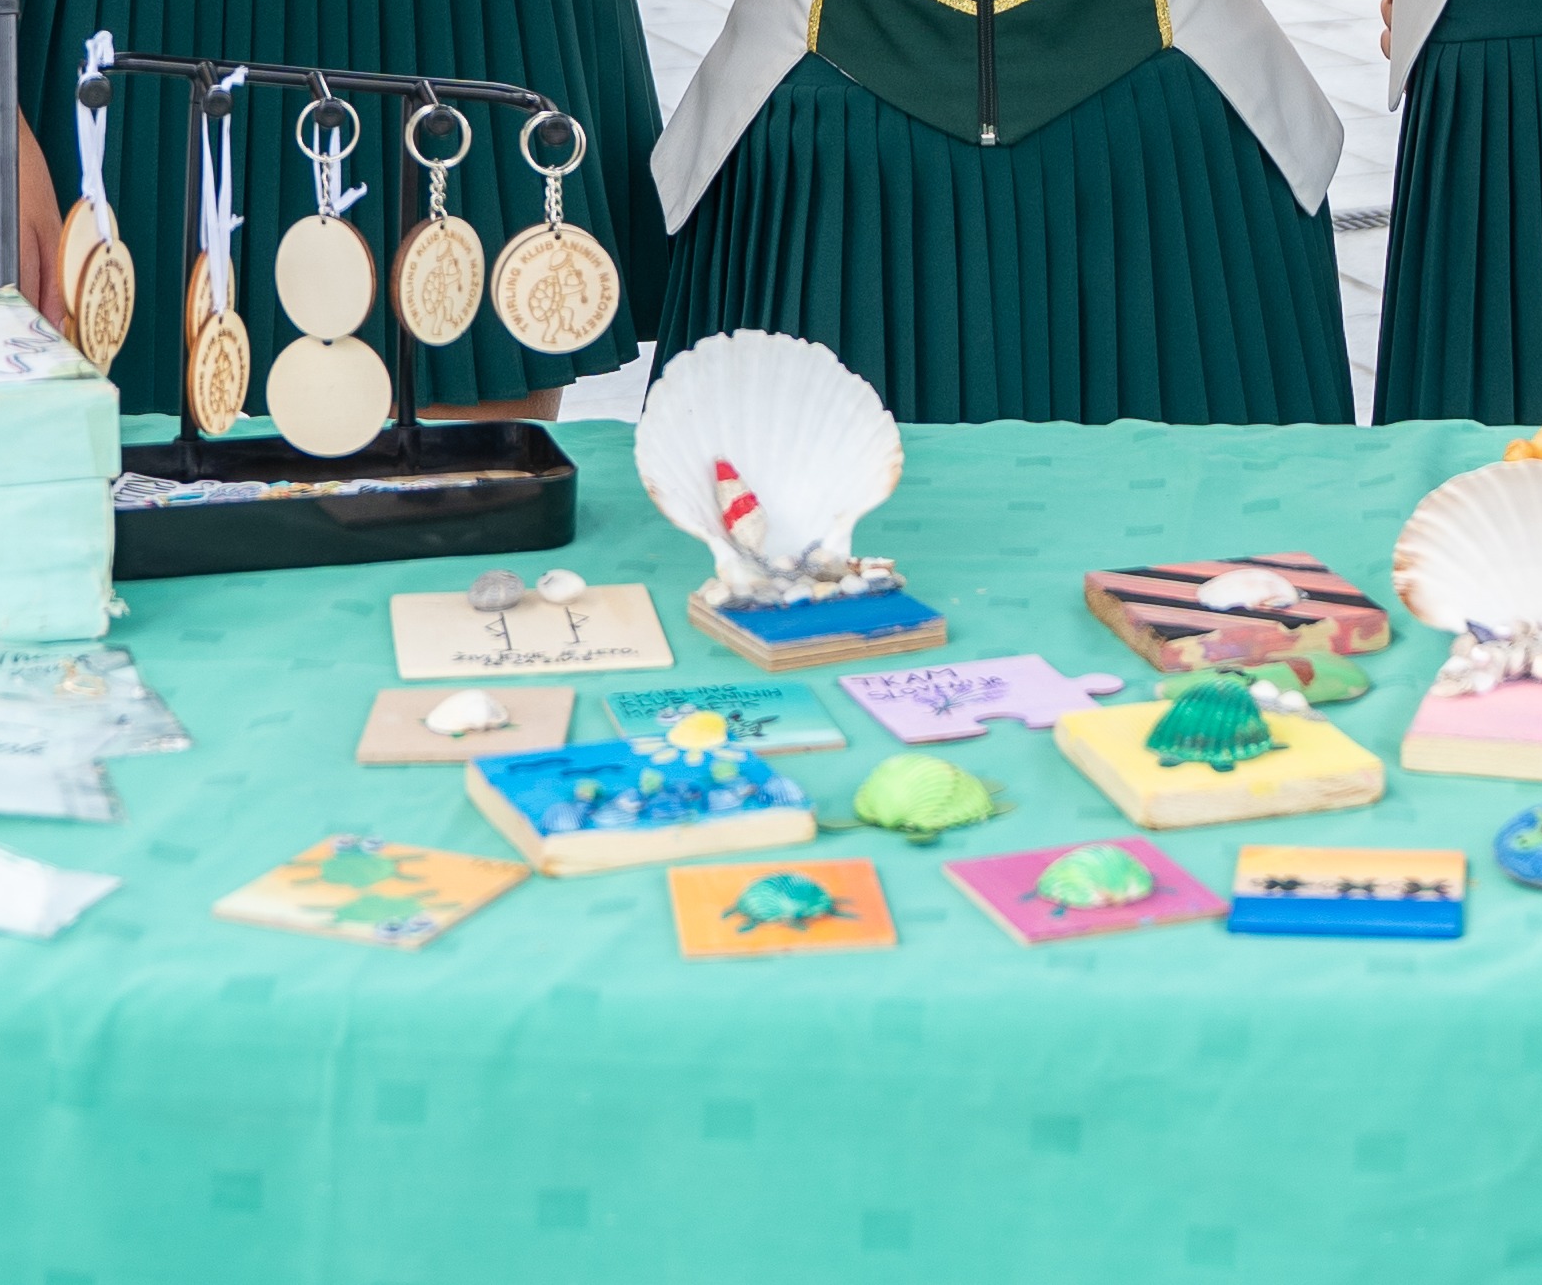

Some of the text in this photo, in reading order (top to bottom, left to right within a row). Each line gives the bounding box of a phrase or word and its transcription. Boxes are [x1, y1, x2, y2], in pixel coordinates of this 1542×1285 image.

[505, 267, 529, 333] TWIRLING
[520, 240, 554, 264] KLUB
[851, 667, 957, 687] TKAM
[612, 683, 737, 701] TWIRLING
